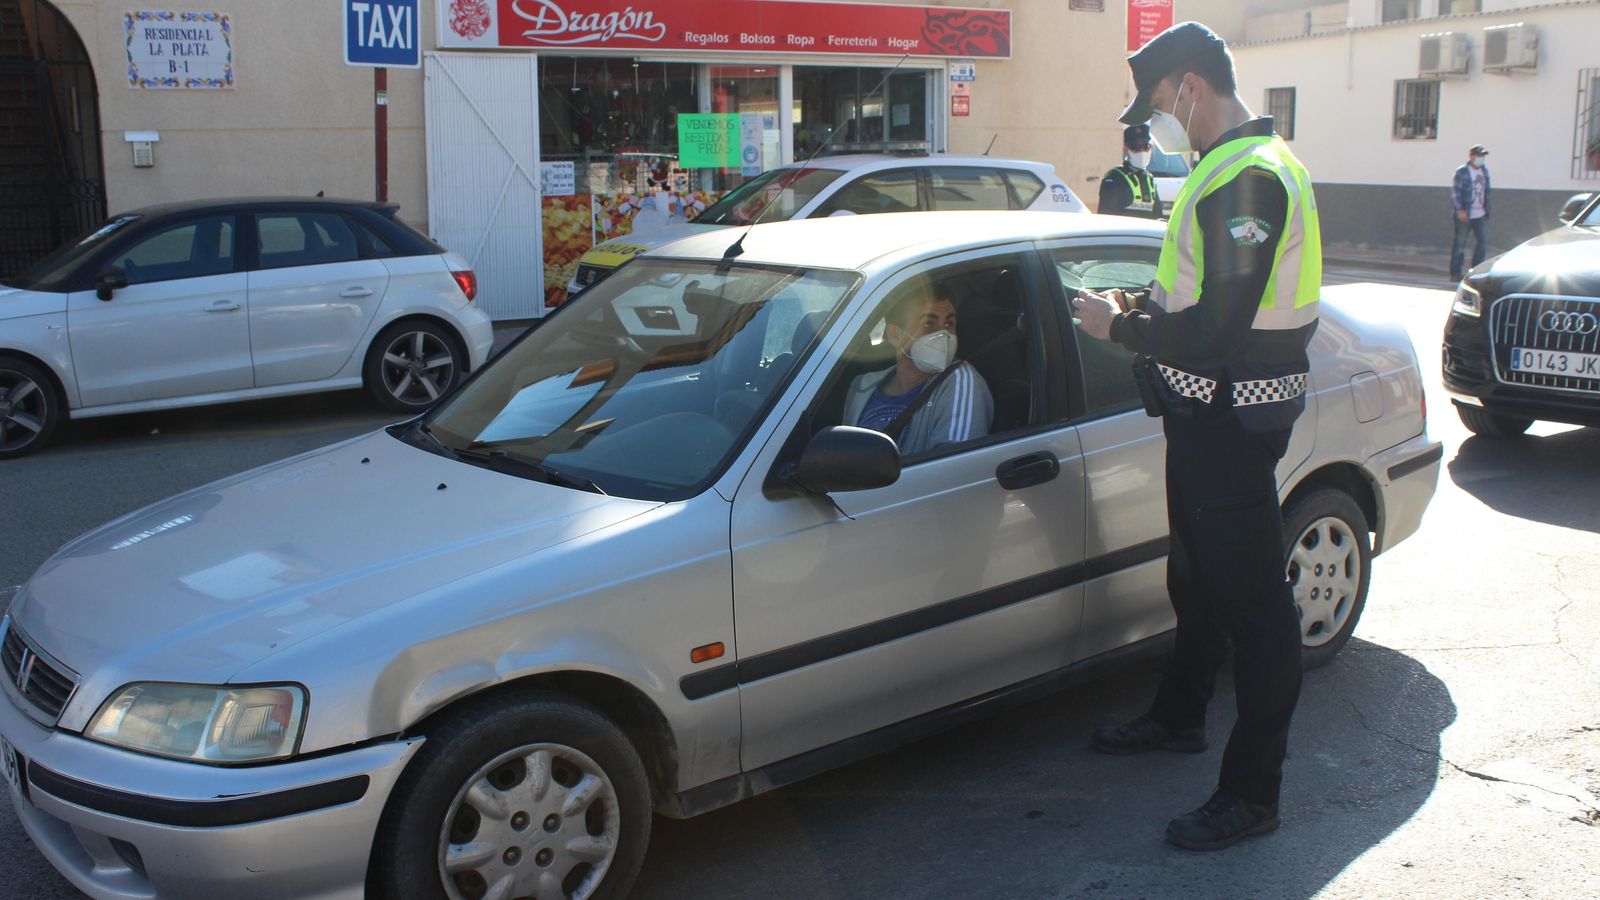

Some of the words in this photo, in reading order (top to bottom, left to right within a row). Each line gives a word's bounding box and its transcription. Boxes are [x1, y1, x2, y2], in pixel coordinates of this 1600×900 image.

[352, 2, 412, 49] TAXI
[511, 0, 666, 44] Dragón
[144, 28, 213, 41] RESIDENCIAL
[685, 31, 729, 46] Regalos
[740, 33, 775, 44] Bolsos
[787, 34, 815, 47] Ropa
[888, 37, 919, 50] Hogar
[149, 43, 164, 56] LA
[172, 43, 210, 56] PLATA
[168, 60, 188, 73] B-1
[685, 119, 735, 130] VENDEMOS
[1052, 194, 1071, 203] 092
[1523, 351, 1568, 372] 0143
